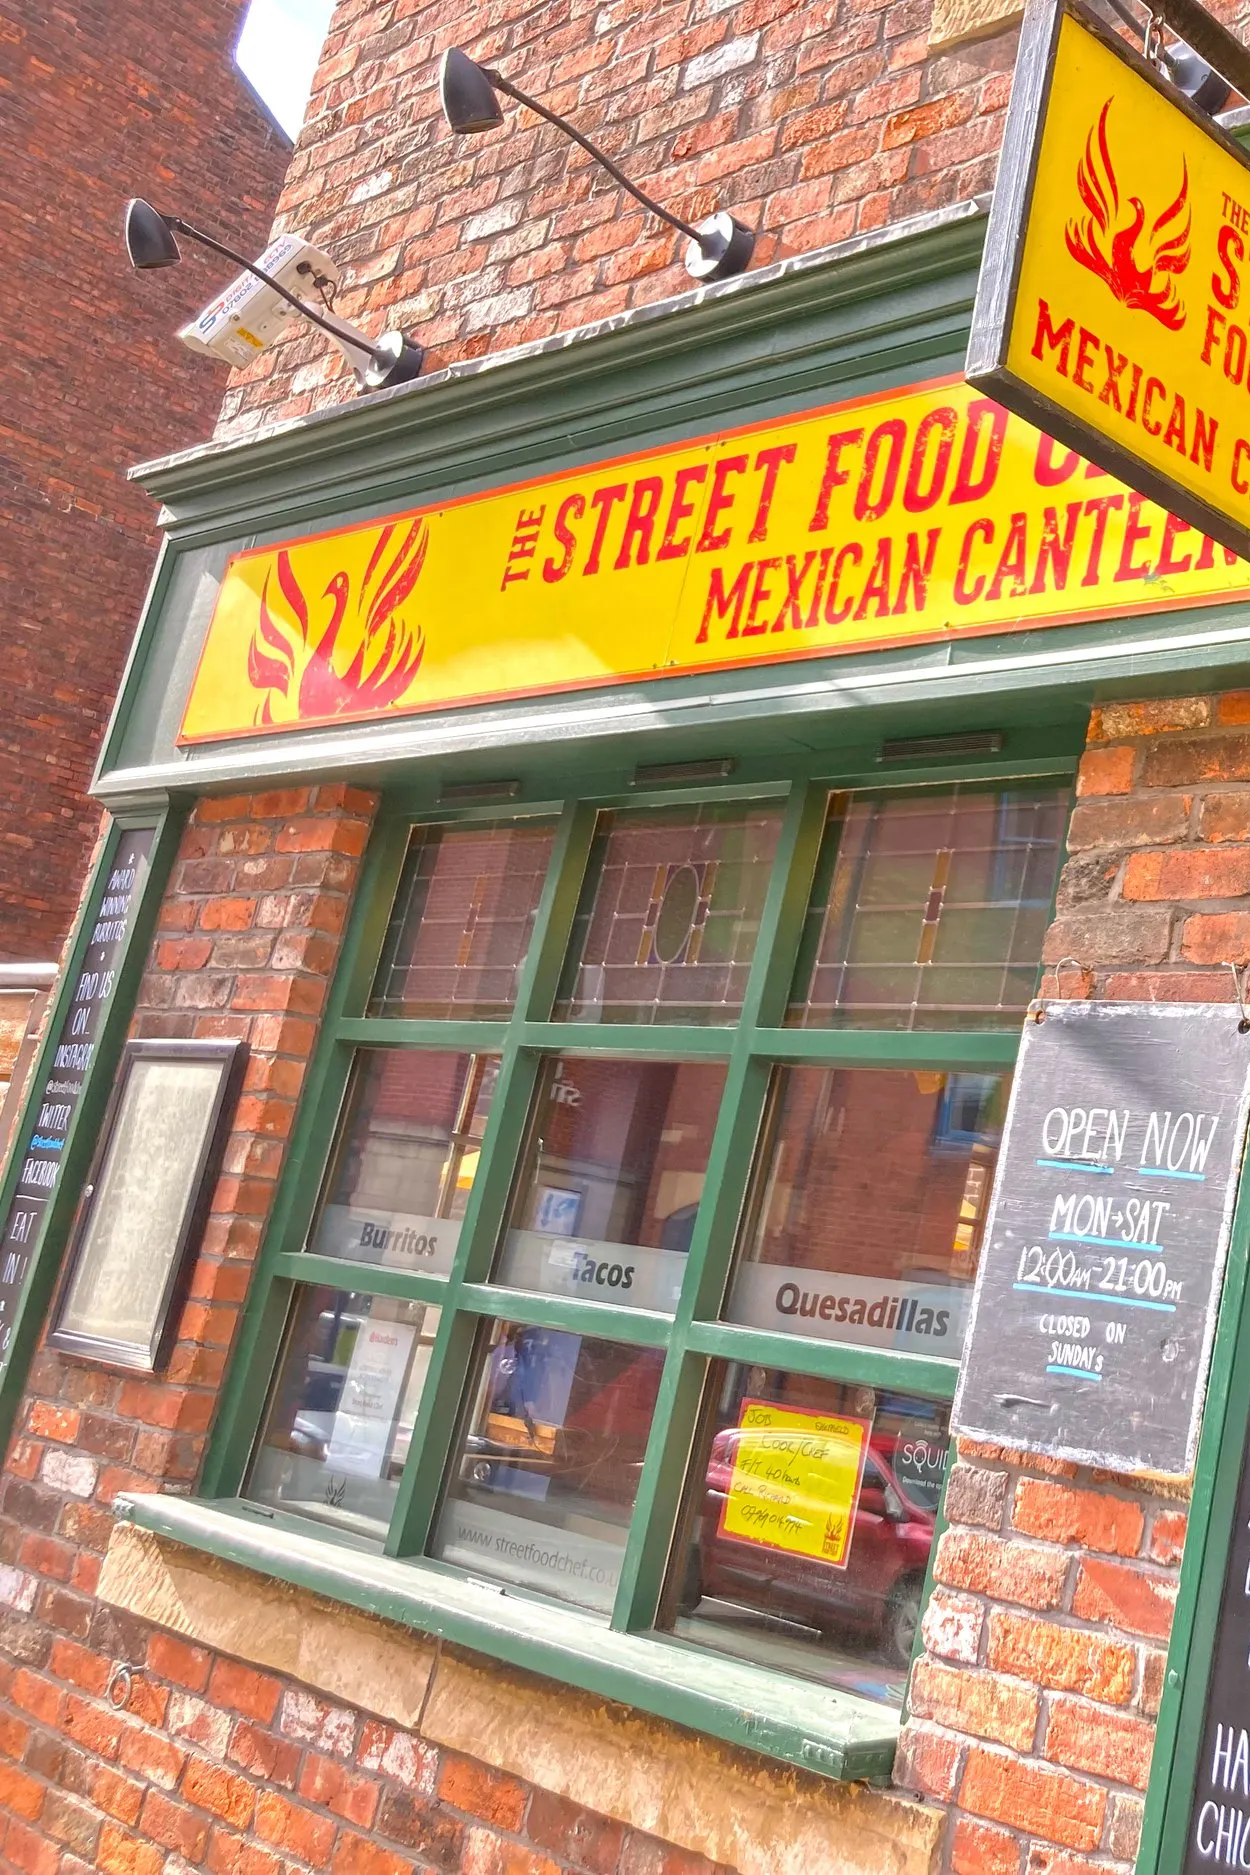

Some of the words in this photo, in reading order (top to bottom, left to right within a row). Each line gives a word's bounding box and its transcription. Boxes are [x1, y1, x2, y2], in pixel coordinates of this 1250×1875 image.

[1221, 191, 1250, 236] THE
[1031, 298, 1219, 472] MEXICAN
[542, 443, 798, 583] STREET
[809, 398, 1010, 533] FOOD
[500, 504, 547, 592] THE
[695, 527, 941, 644] MEXICAN
[108, 868, 136, 891] AWARD
[91, 919, 128, 946] BURRITOS
[75, 971, 99, 1002] FIND
[99, 970, 115, 999] US
[38, 1102, 72, 1131] TWITTER
[1042, 1107, 1129, 1162] OPEN
[1140, 1111, 1220, 1173] NOW
[21, 1157, 60, 1188] FACEBOOK
[10, 1211, 37, 1243] EAT
[359, 1222, 438, 1257] Burritos
[572, 1251, 635, 1289] Tacos
[775, 1282, 950, 1337] Quesadillas
[1039, 1313, 1090, 1338] CLOSED
[1105, 1321, 1127, 1344] ON
